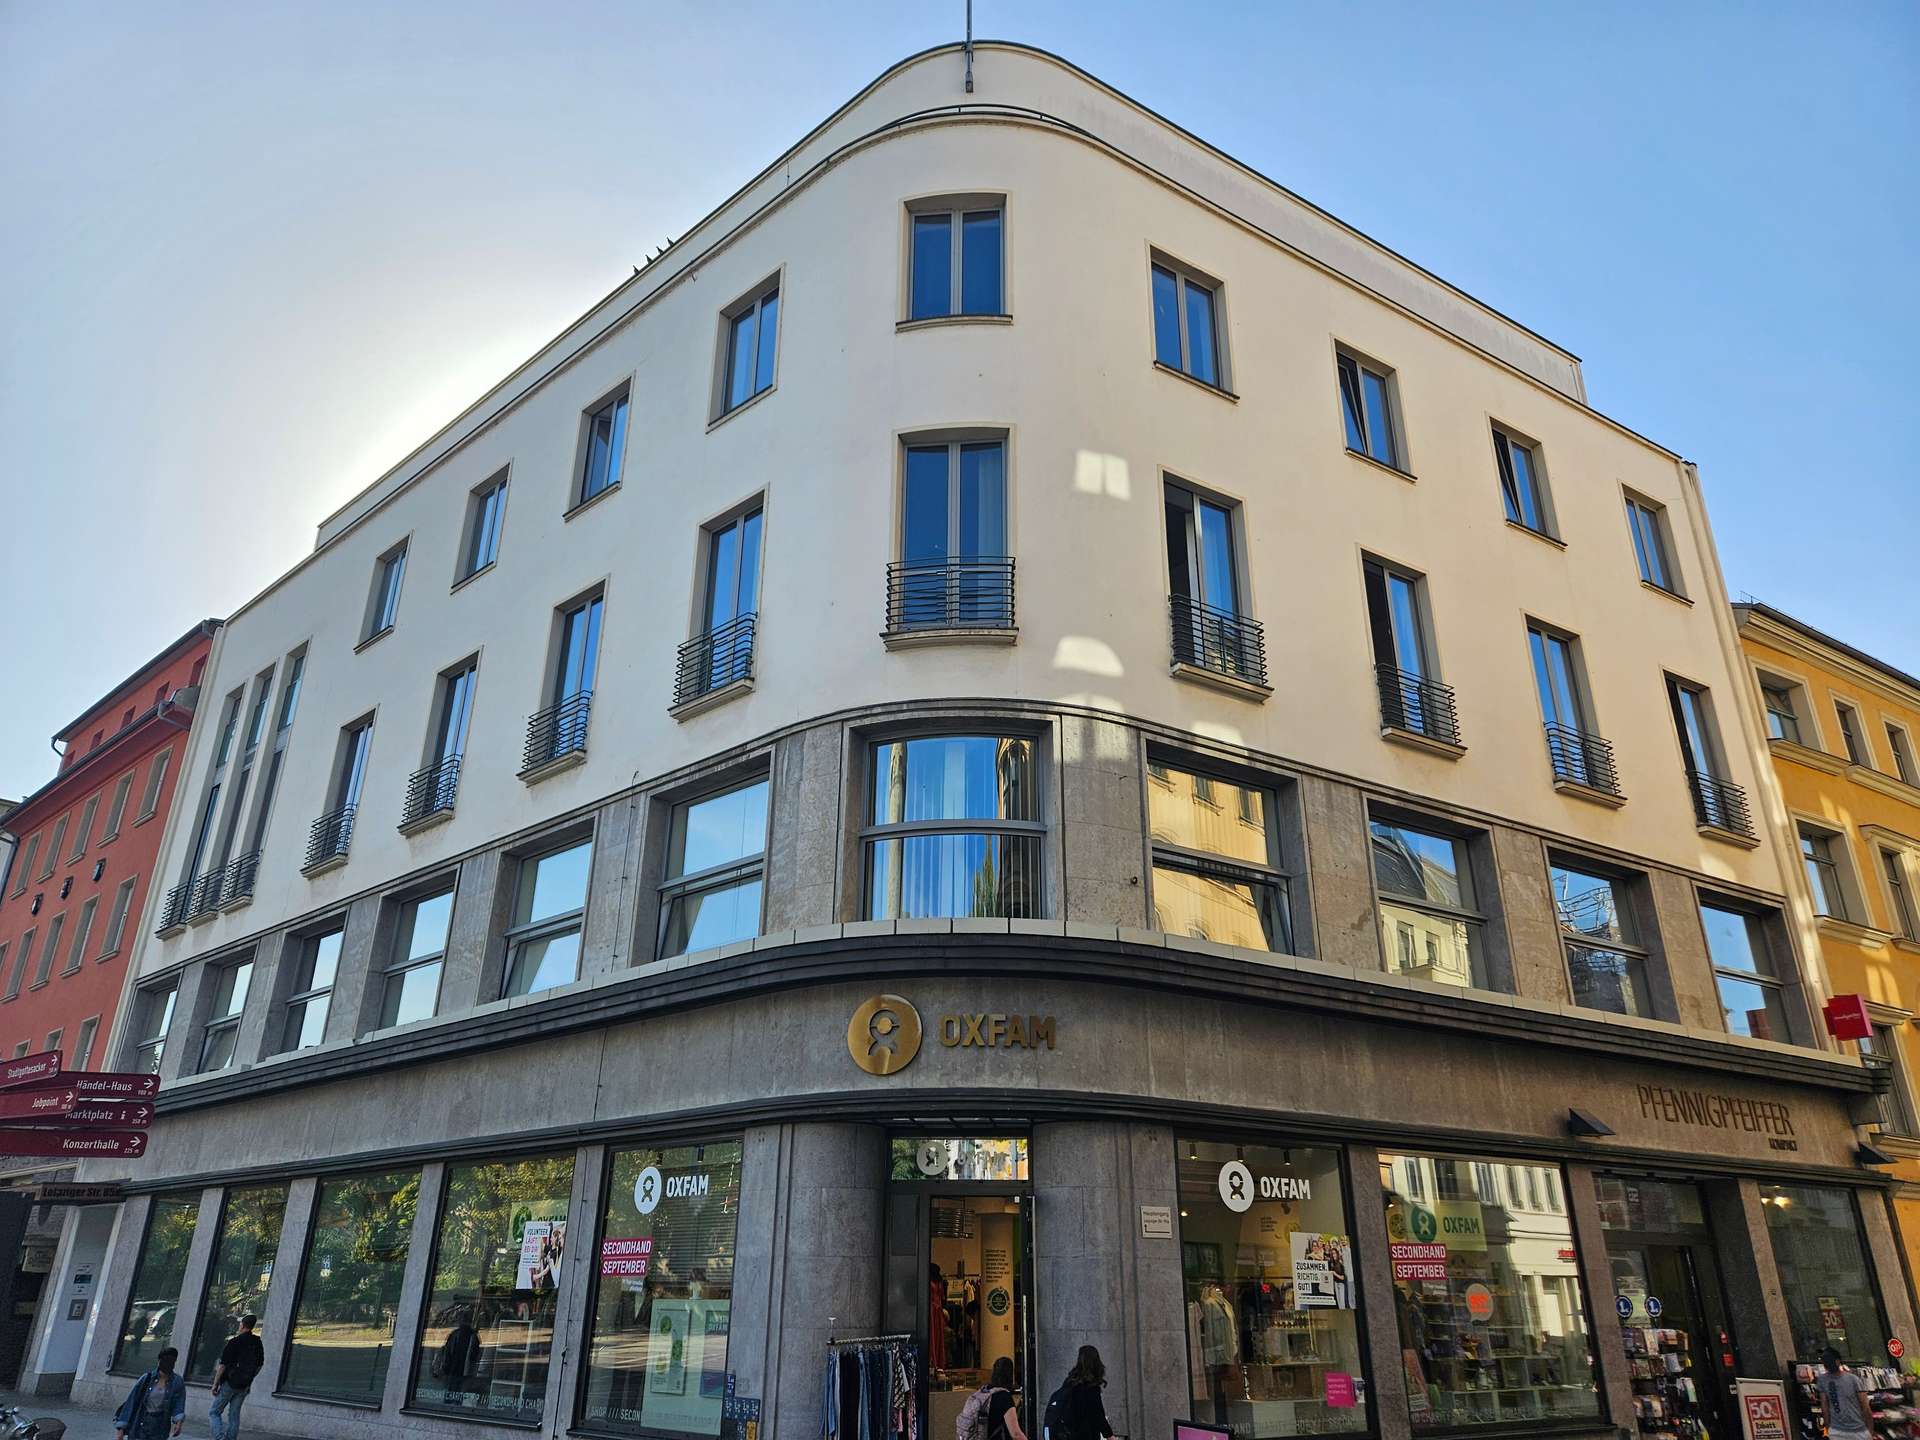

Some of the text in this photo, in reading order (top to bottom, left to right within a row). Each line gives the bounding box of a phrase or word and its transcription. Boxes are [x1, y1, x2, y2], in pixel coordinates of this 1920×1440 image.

[940, 1014, 1056, 1049] OXFAM
[76, 1080, 133, 1091] Händel-Haus
[65, 1110, 114, 1122] Marktplatz
[1637, 1084, 1795, 1135] PFENNIGPFEIFFER
[62, 1138, 120, 1150] Konzerthalle
[666, 1175, 709, 1197] OXFAM
[1260, 1176, 1311, 1200] OXFAM
[1443, 1216, 1481, 1234] OXFAM
[603, 1241, 652, 1255] SECONDHAND
[1391, 1245, 1446, 1258] SECONDHAND
[603, 1260, 646, 1274] SEPTEMBER
[1397, 1264, 1446, 1278] SEPTEMBER
